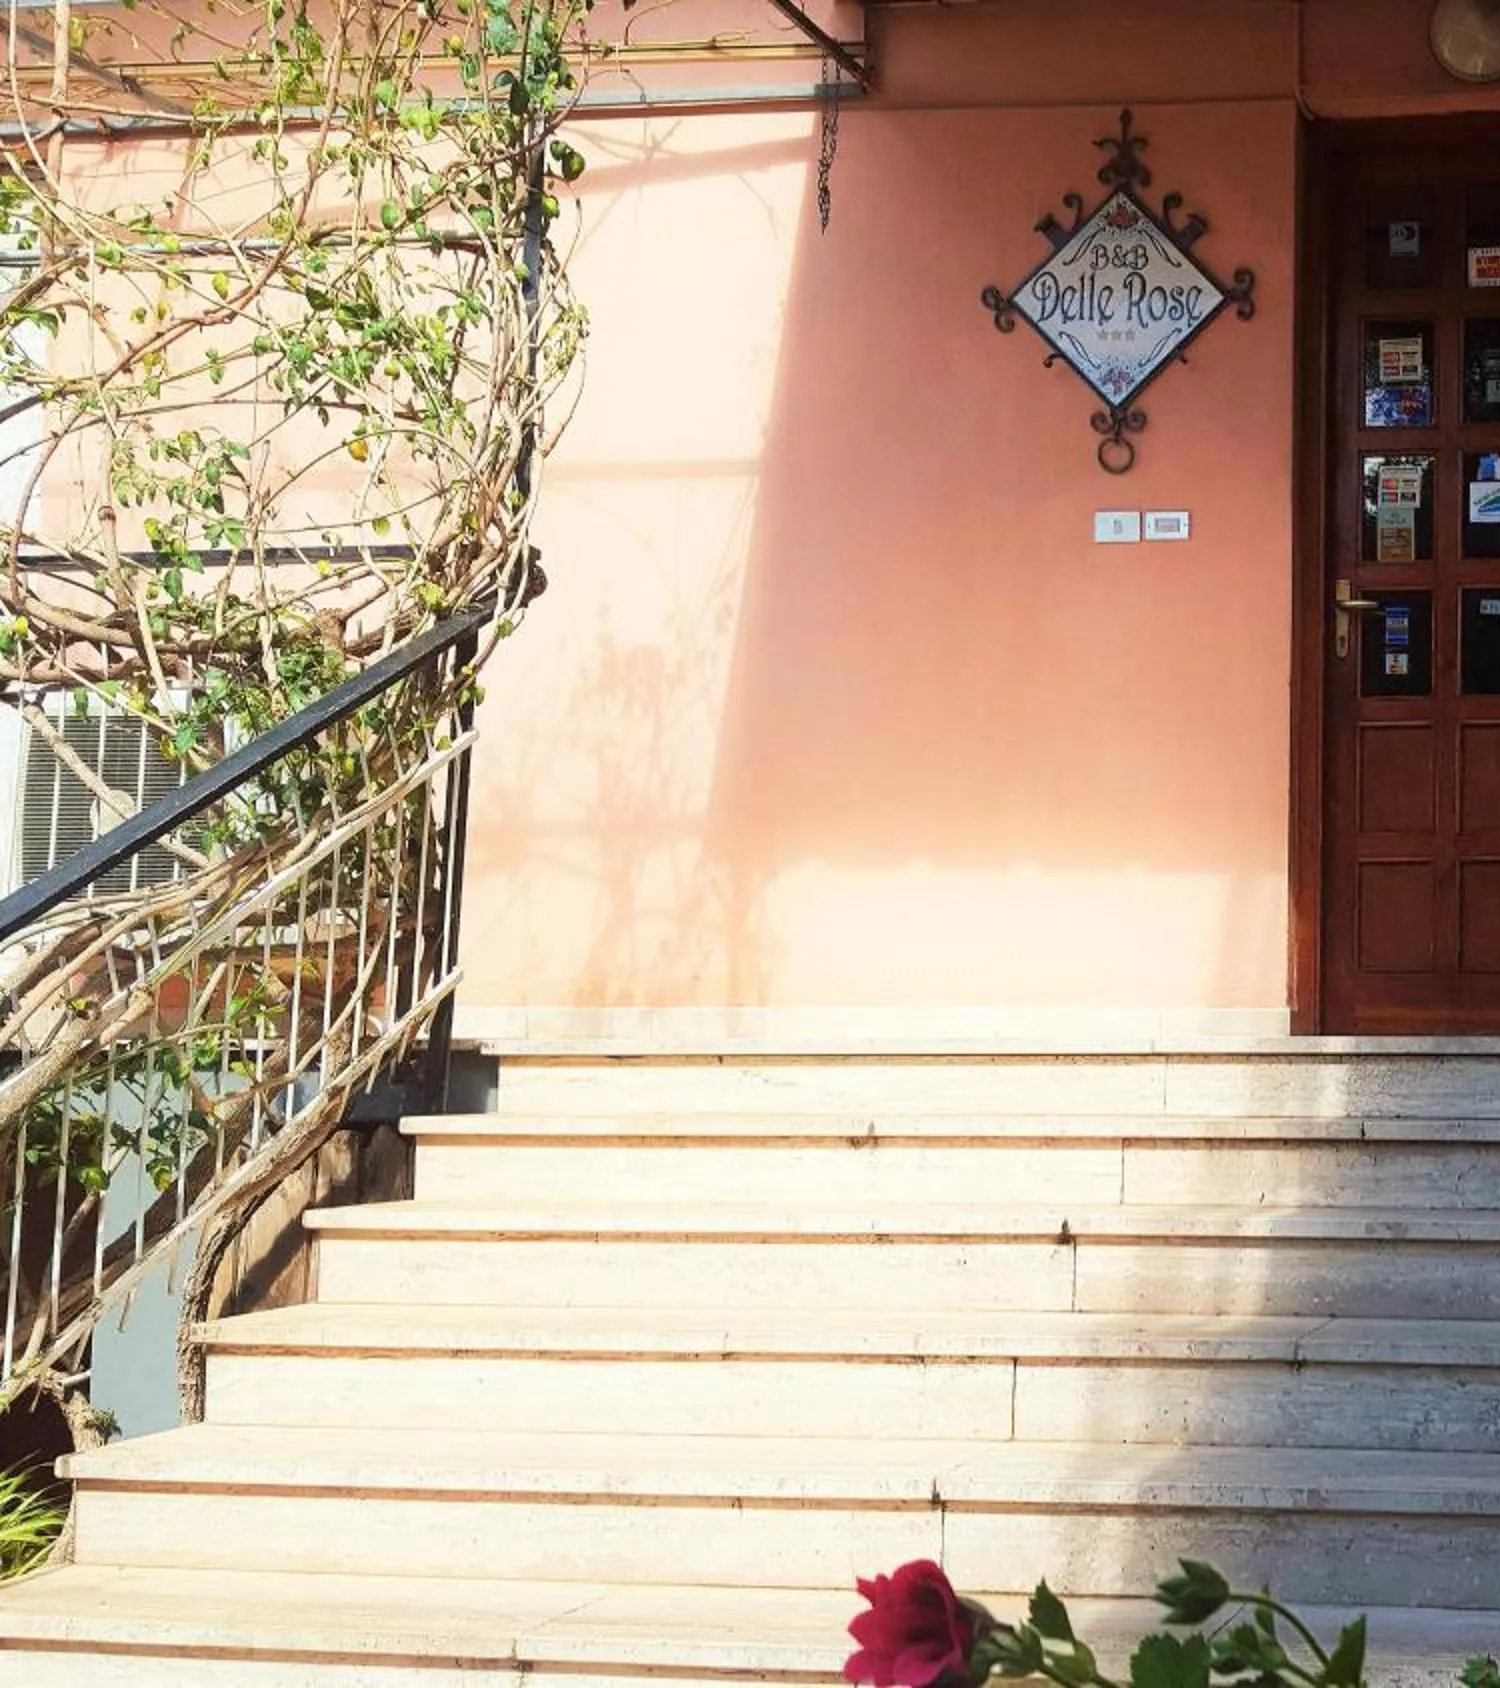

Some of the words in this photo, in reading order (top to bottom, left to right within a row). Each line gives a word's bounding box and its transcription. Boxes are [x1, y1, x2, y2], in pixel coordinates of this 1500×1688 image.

[1089, 243, 1149, 271] B&B
[1031, 271, 1115, 326] Delle
[1122, 271, 1203, 328] Rose
